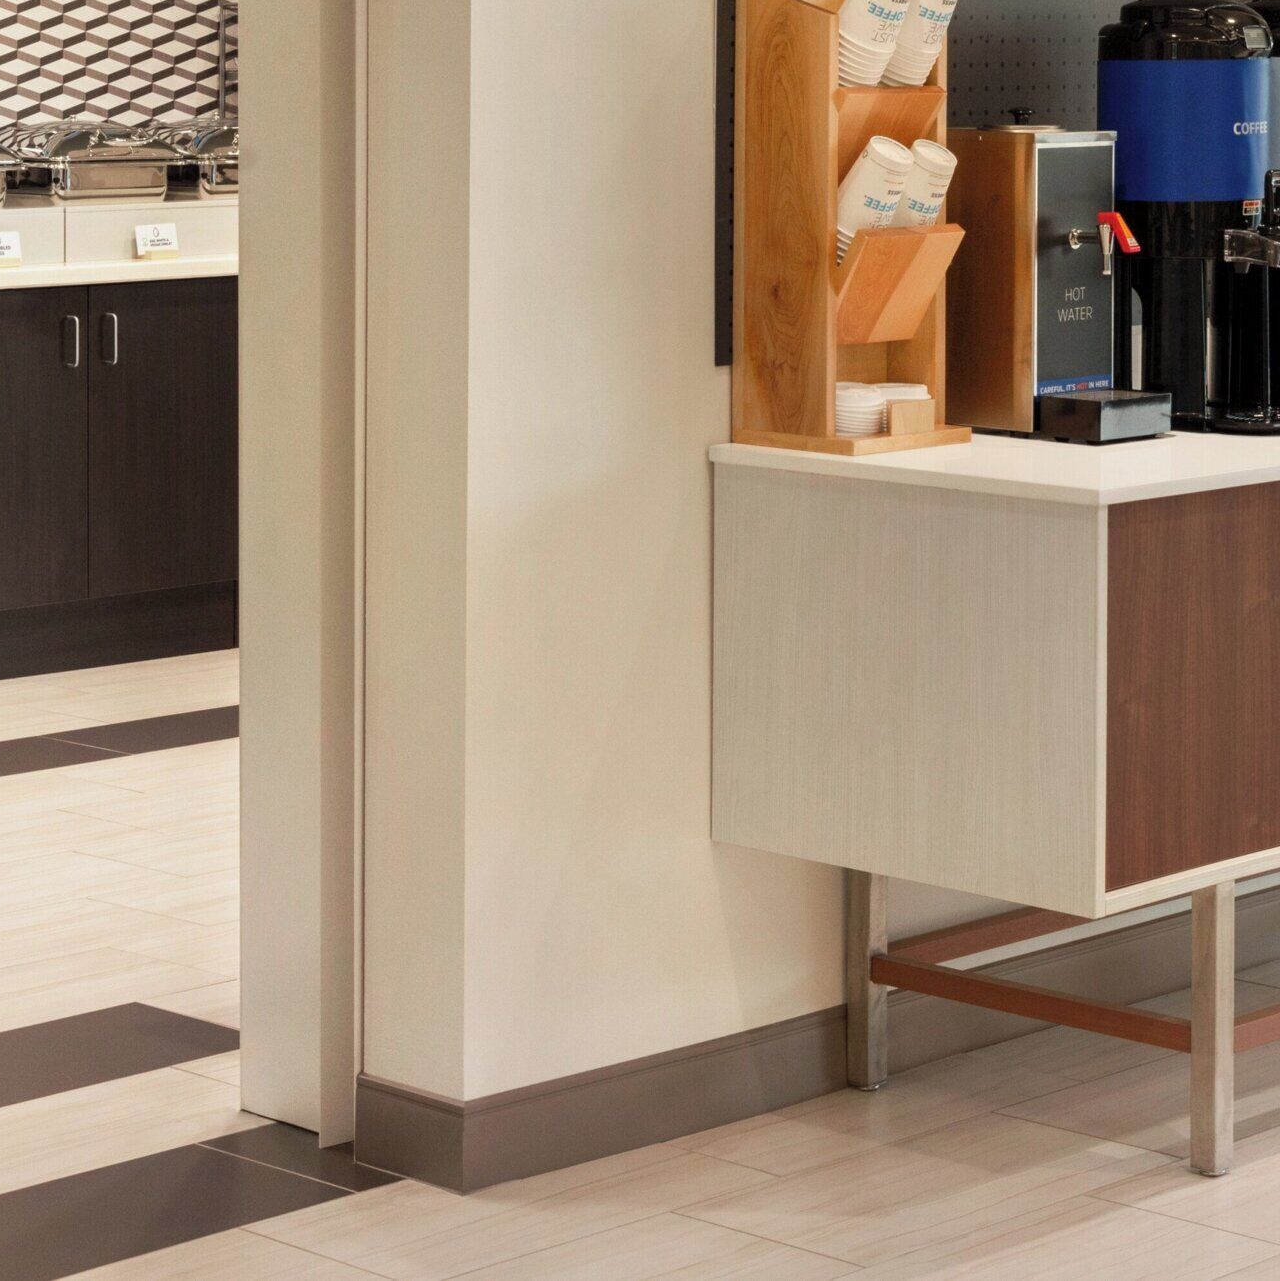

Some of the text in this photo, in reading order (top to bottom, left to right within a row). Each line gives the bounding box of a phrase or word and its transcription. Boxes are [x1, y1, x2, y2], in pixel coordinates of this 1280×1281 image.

[1233, 121, 1268, 135] COFFEE
[1065, 287, 1086, 301] HOT
[1057, 306, 1093, 322] WATER
